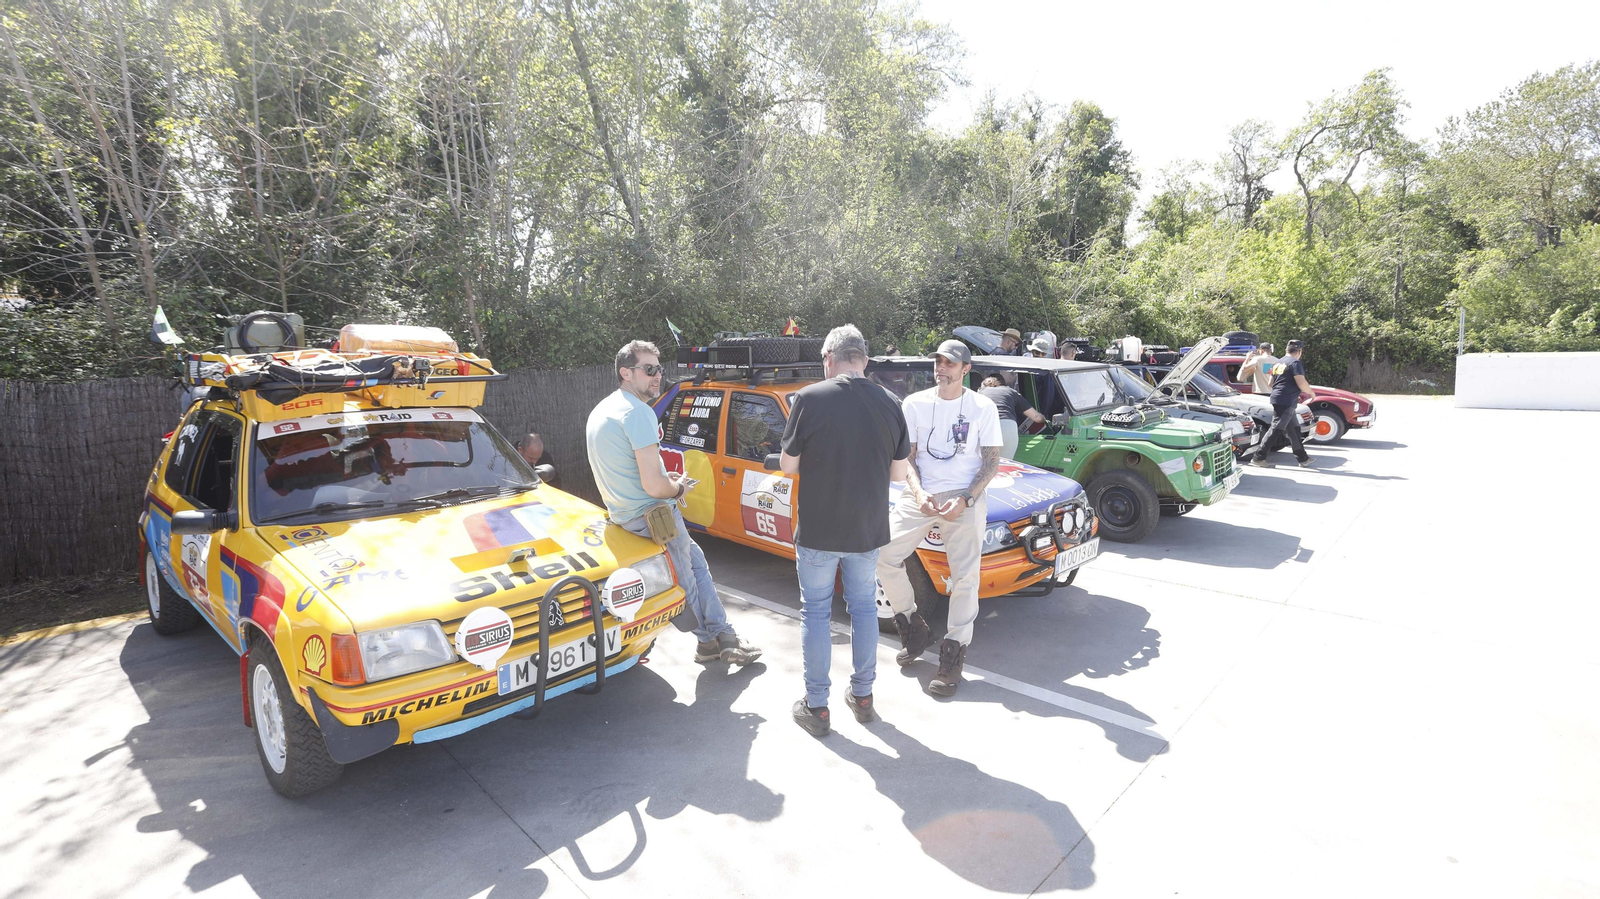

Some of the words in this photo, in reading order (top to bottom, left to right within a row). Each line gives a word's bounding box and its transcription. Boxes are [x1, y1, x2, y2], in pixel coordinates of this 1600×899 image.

[281, 398, 323, 411] 205
[693, 396, 722, 407] ANTONIO
[690, 407, 711, 418] LAURA
[756, 511, 777, 536] 65
[928, 530, 941, 540] Ess
[451, 551, 600, 602] Shell
[621, 584, 643, 599] SIRIUS
[624, 603, 685, 640] MICHELIN
[479, 625, 510, 644] SIRIUS
[361, 680, 490, 725] MICHELIN
